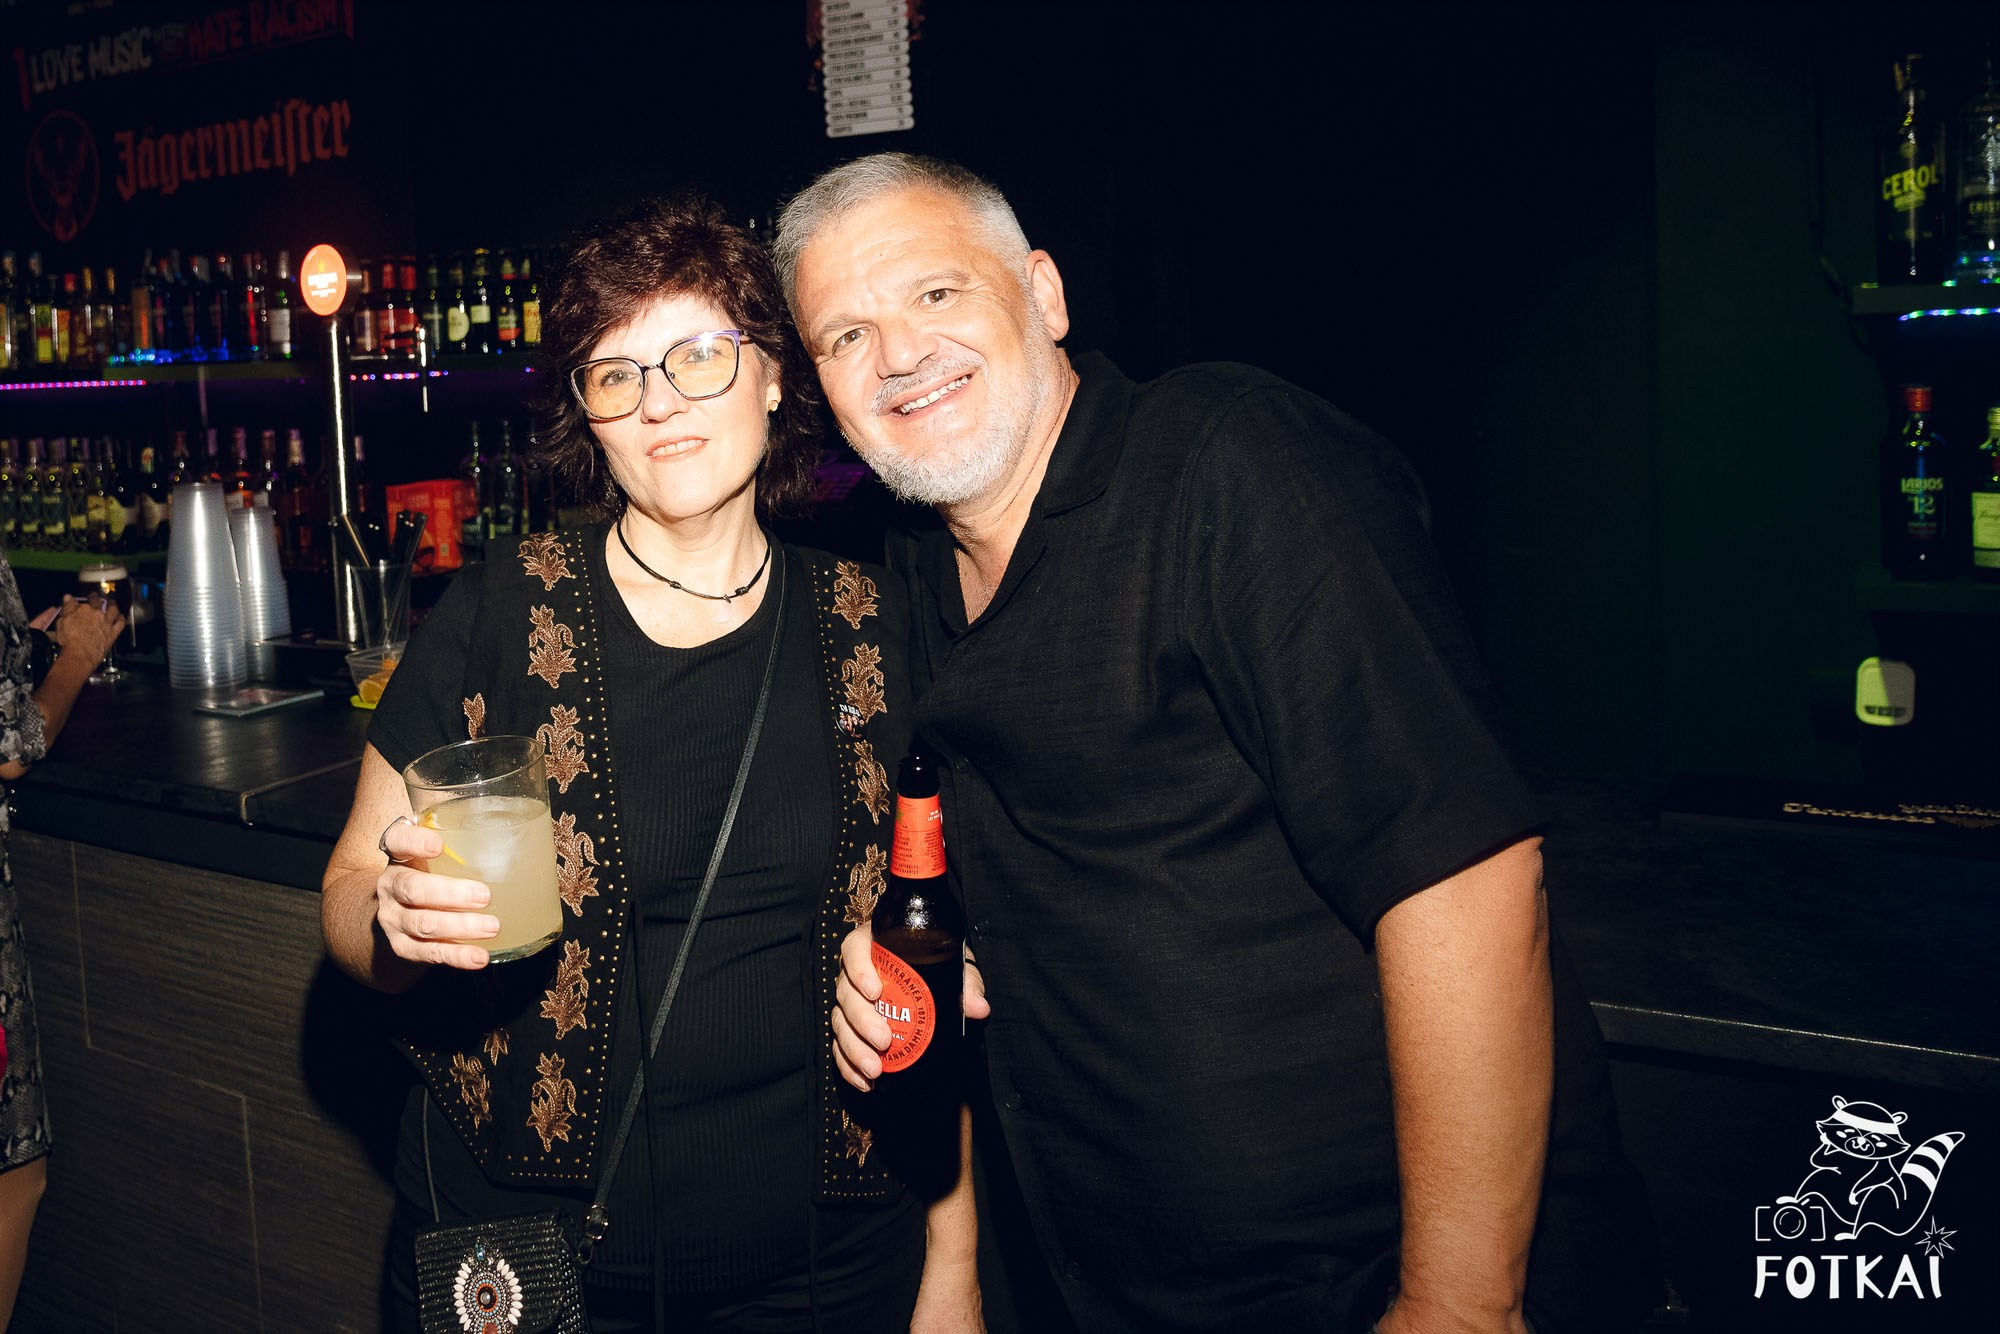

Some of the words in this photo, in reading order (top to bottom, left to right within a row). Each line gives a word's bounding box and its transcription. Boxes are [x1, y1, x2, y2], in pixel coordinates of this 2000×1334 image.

[30, 44, 85, 94] LOVE
[88, 25, 153, 80] MUSIC
[187, 8, 244, 59] HATE
[249, 0, 338, 44] RACISM
[113, 97, 352, 204] Jägermeister
[1882, 163, 1939, 200] CEROL
[1908, 495, 1936, 515] 12
[916, 1006, 926, 1026] 1876
[904, 1029, 924, 1054] DAMM
